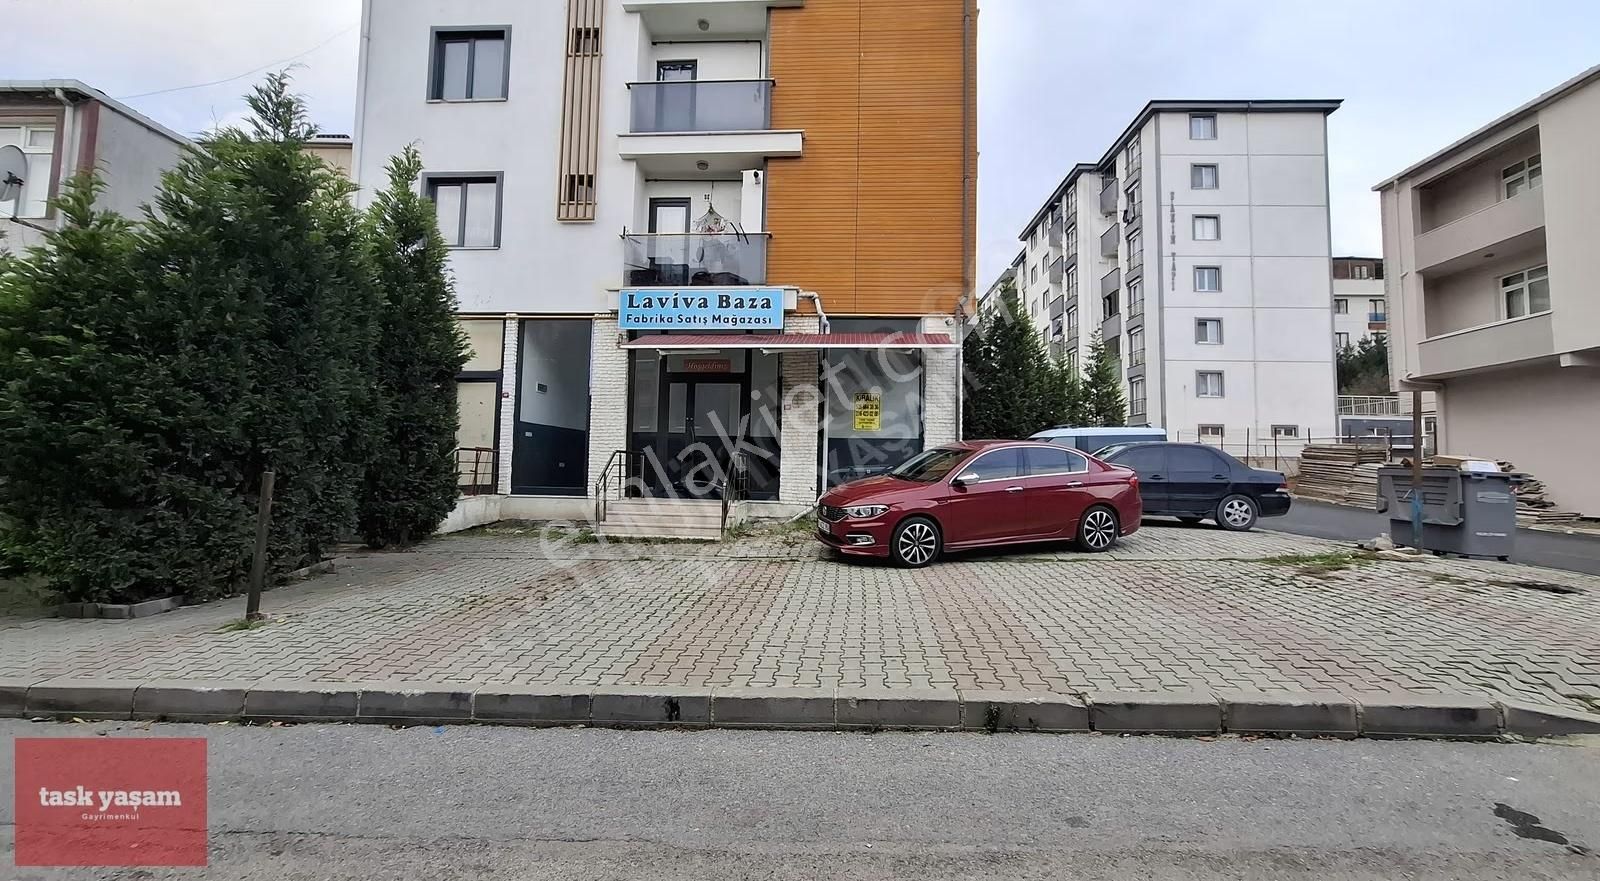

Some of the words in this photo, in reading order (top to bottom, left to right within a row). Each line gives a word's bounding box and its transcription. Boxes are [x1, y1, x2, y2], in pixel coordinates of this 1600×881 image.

[627, 292, 709, 309] Laviva
[717, 294, 772, 309] Baza
[626, 313, 673, 324] Fabrika
[677, 313, 708, 325] Satış
[711, 313, 772, 326] Mağazası
